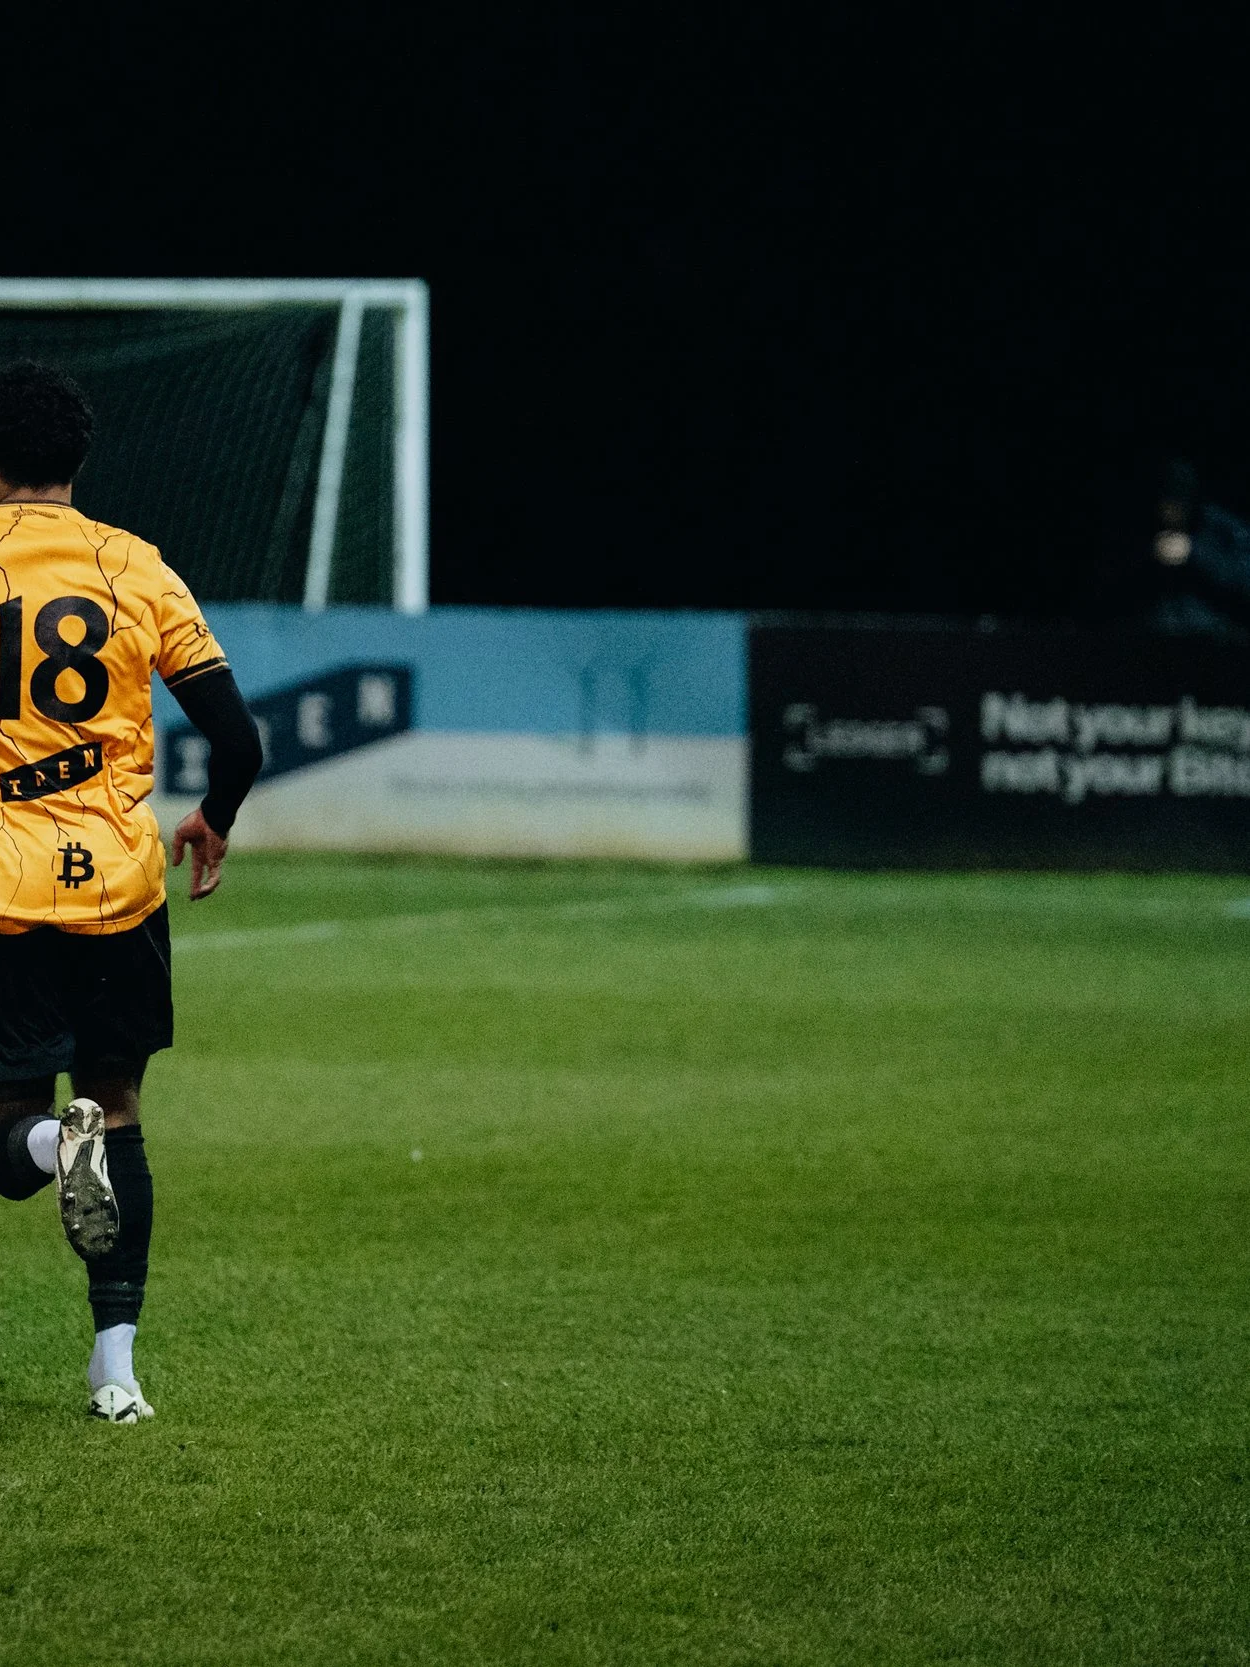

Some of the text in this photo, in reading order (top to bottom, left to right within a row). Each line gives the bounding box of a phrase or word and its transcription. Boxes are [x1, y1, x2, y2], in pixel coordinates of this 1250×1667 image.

[982, 693, 1068, 742] Not
[1073, 704, 1173, 750] your
[982, 751, 1059, 793] not
[1064, 755, 1165, 801] your
